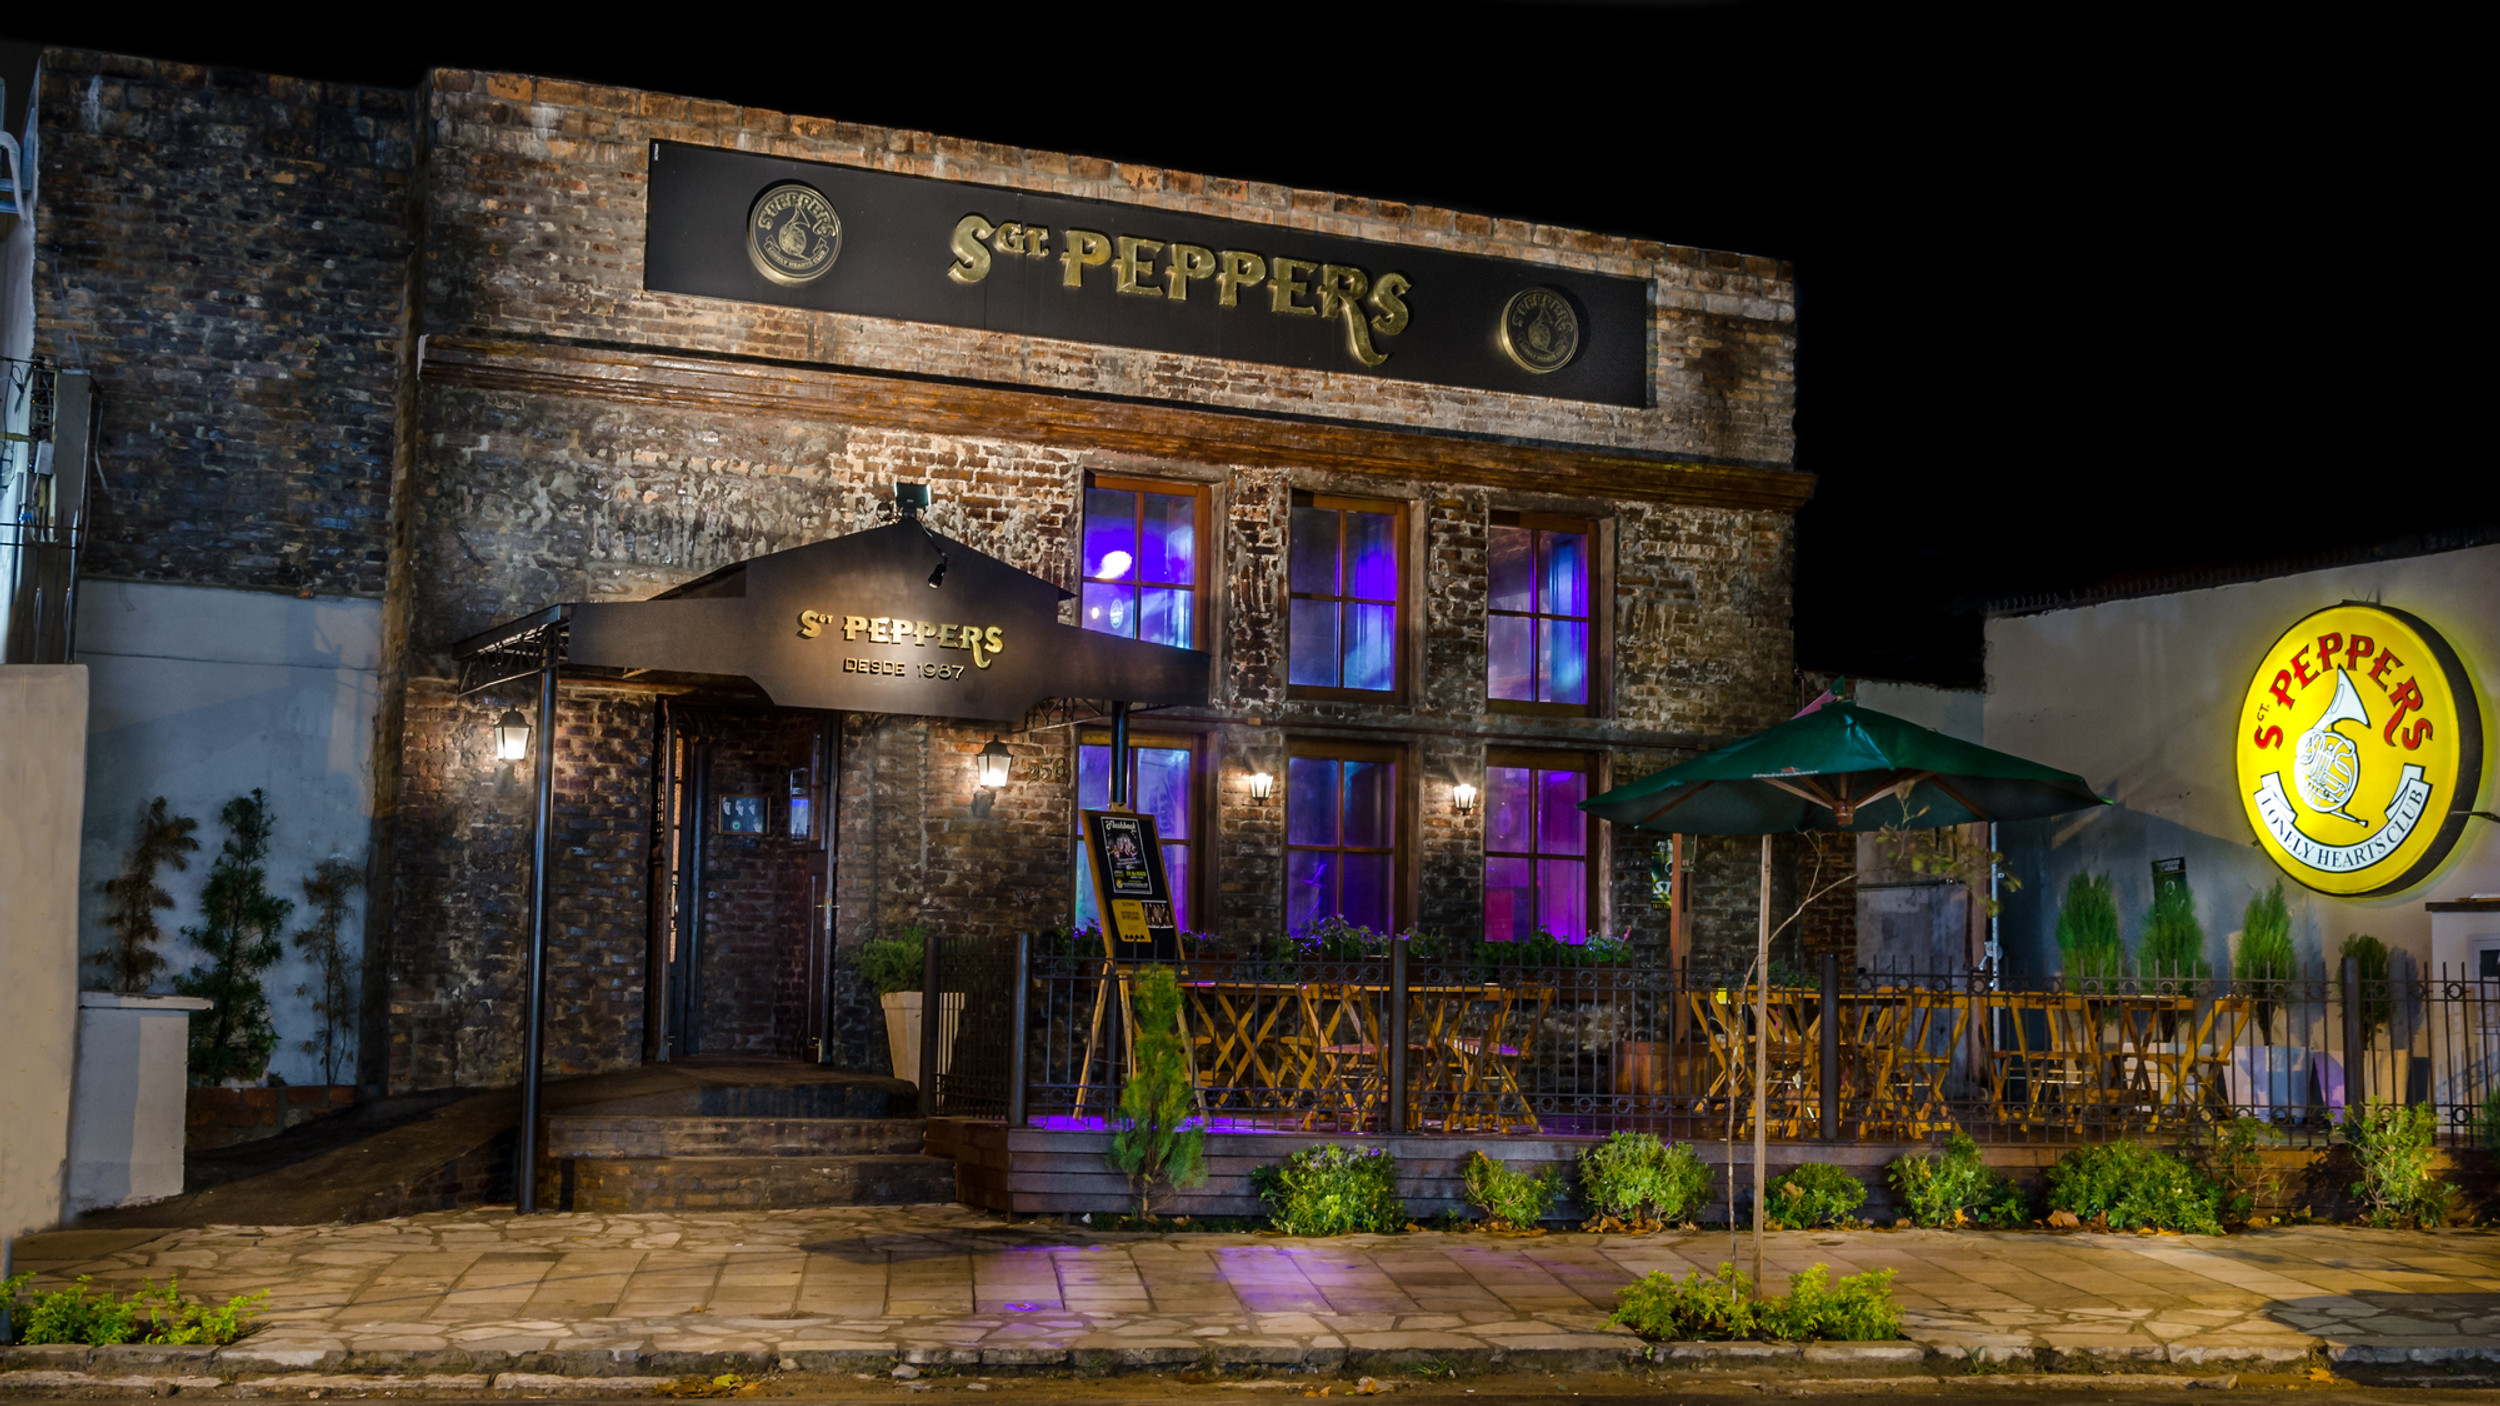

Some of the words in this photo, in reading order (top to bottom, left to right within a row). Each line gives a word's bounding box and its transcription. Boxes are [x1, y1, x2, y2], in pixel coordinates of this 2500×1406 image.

[1060, 228, 1413, 367] PEPPERS
[843, 615, 1004, 669] PEPPERS
[844, 657, 906, 677] DESDE
[917, 662, 965, 680] 1987
[2269, 632, 2434, 750] PEPPERS
[2261, 797, 2315, 860] LONELY
[2317, 837, 2388, 869] HEARTS
[2386, 788, 2424, 844] CLUB
